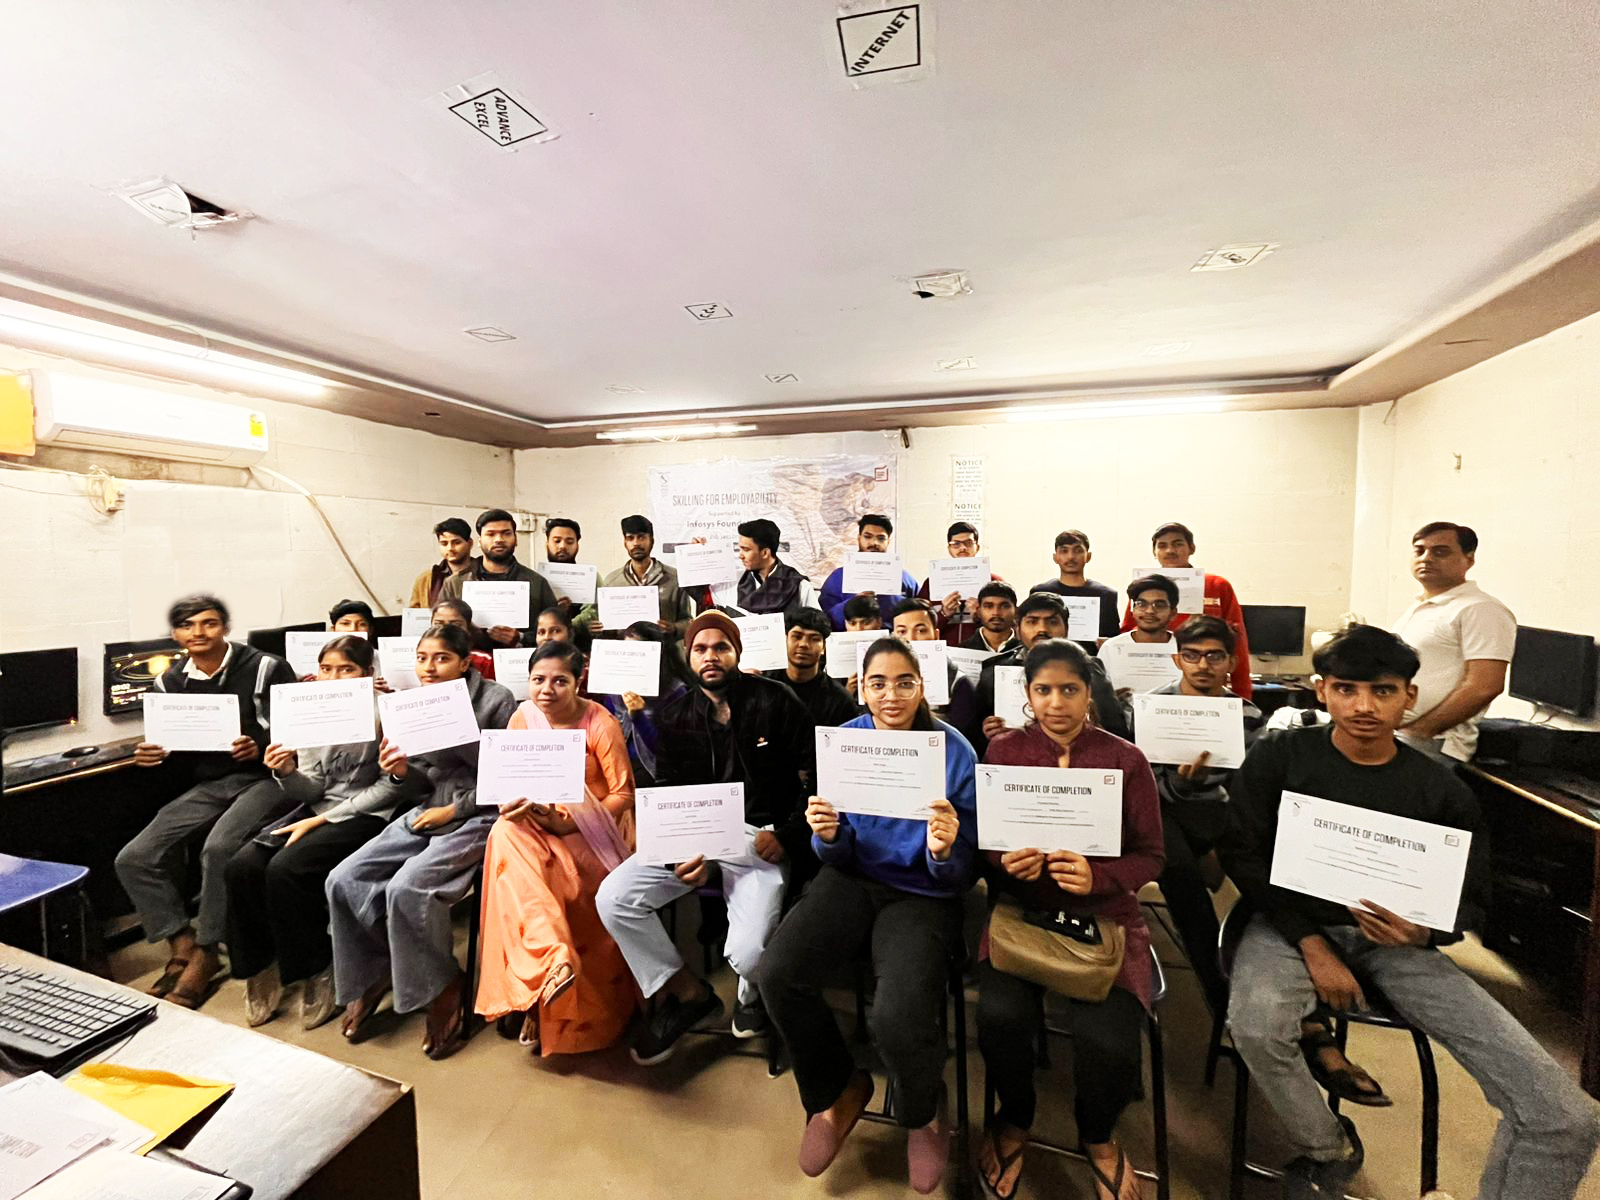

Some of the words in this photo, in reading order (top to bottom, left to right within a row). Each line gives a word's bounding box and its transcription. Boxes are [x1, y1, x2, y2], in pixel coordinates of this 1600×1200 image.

[851, 10, 910, 72] INTERNET
[474, 102, 490, 128] EXCEL
[494, 96, 512, 141] ADVANCE
[672, 495, 704, 506] SKILLING
[706, 494, 720, 505] FOR
[721, 492, 778, 505] EMPLOYABILITY
[687, 520, 715, 529] Infosys
[501, 744, 529, 752] CERTIFICATE
[535, 744, 565, 752] COMPLETION
[841, 745, 874, 755] CERTIFICATE
[875, 747, 882, 755] OF
[883, 747, 919, 757] COMPLETION
[1004, 784, 1041, 794] CERTIFICATE
[1042, 785, 1050, 794] OF
[1052, 786, 1092, 795] COMPLETION
[657, 801, 686, 810] CERTIFICATE
[693, 799, 723, 808] COMPLETION
[1314, 817, 1360, 837] CERTIFICATE
[1362, 829, 1372, 839] OF
[1374, 832, 1427, 853] COMPLETION
